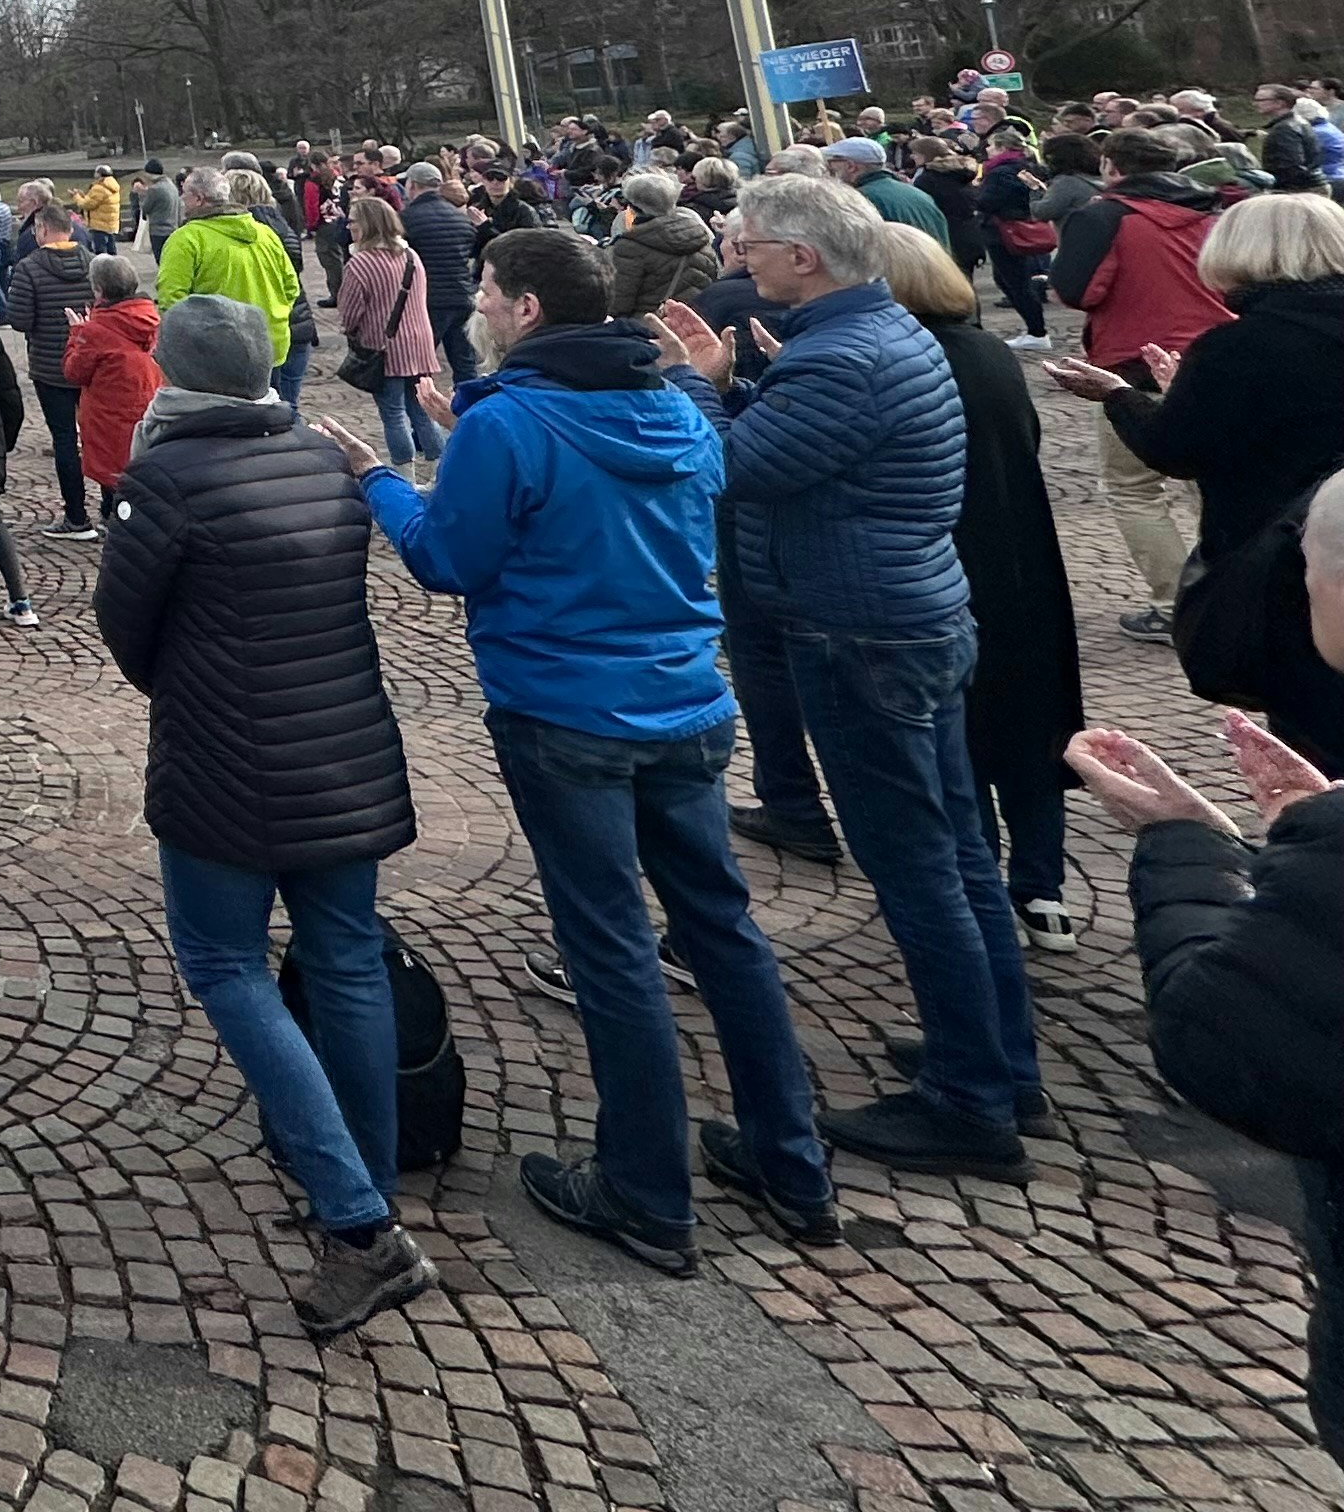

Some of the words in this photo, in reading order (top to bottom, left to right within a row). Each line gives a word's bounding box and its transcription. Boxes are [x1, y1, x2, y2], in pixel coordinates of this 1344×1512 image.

[762, 54, 789, 67] NIE
[790, 46, 852, 63] WIEDER
[773, 63, 796, 75] IST
[799, 57, 847, 73] JETZT!
